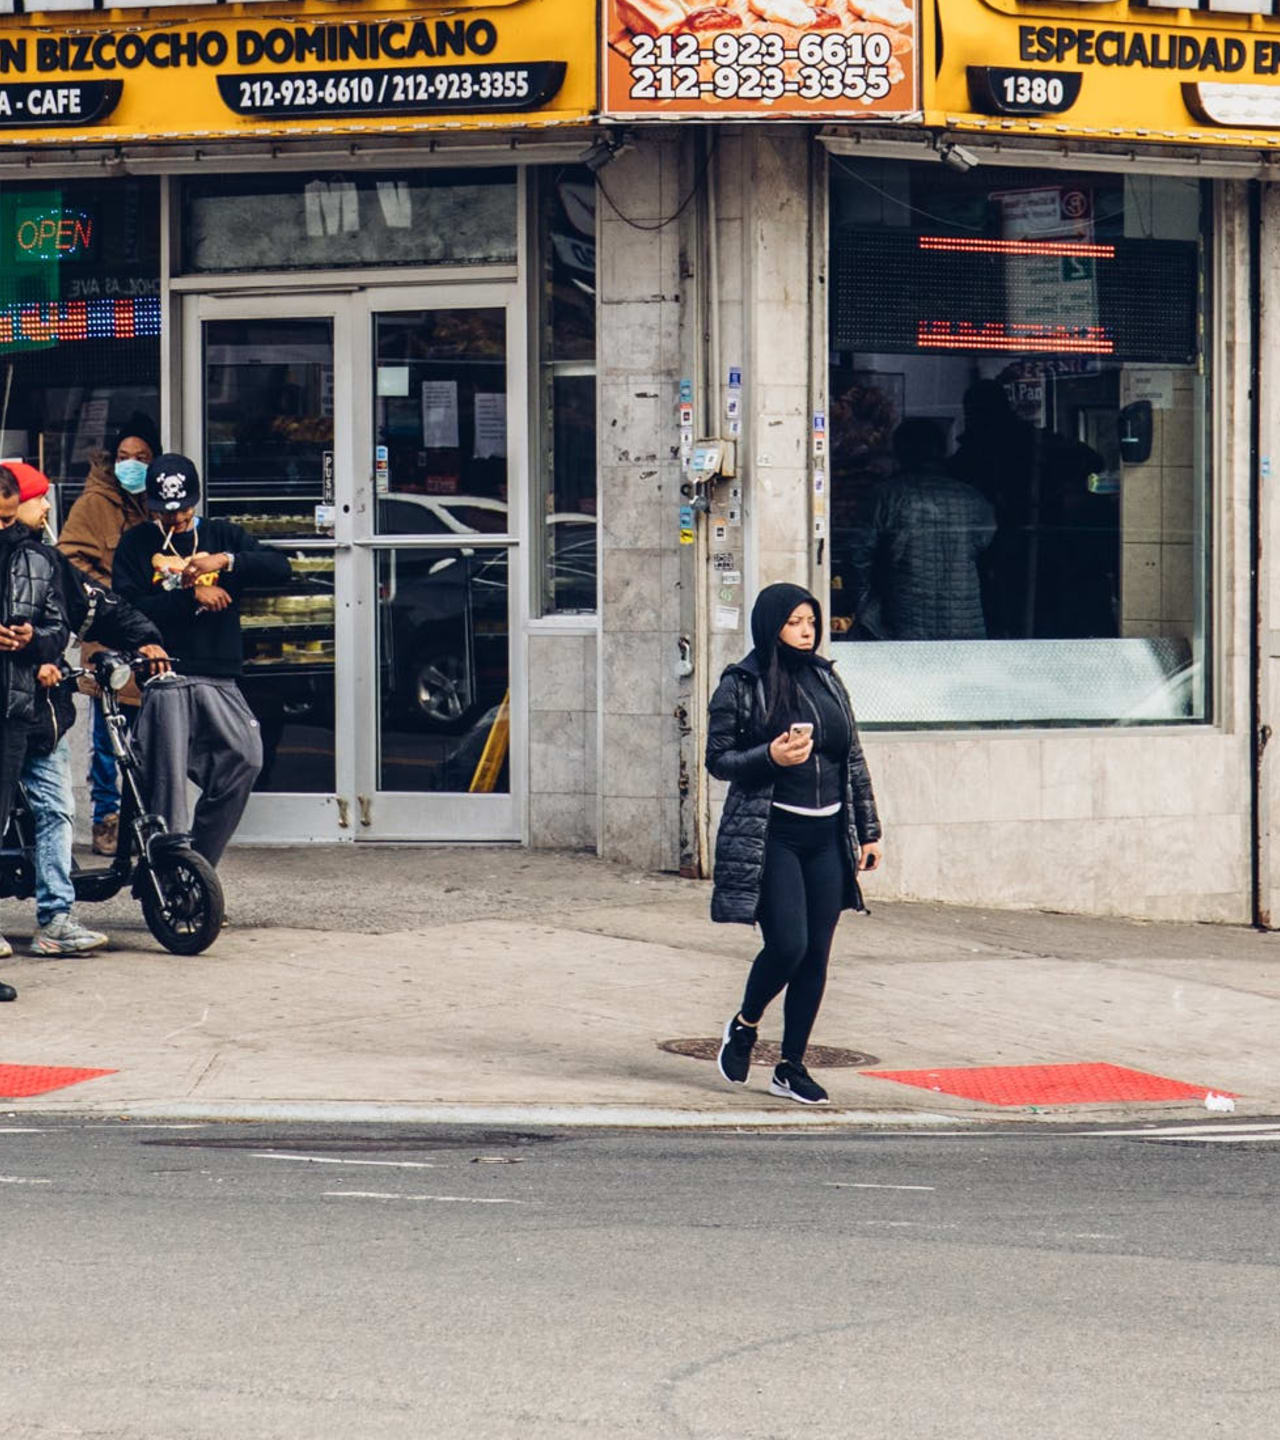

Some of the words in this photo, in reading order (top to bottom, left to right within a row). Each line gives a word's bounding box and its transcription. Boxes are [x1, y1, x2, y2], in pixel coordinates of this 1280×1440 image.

[36, 30, 228, 72] BIZCOCHO
[237, 19, 498, 66] DOMINICANO
[630, 32, 892, 67] 212-923-6610
[1018, 25, 1247, 73] ESPECIALIDAD
[239, 77, 374, 108] 212-923-6610
[392, 71, 530, 102] 212-923-3355
[629, 66, 891, 100] 212-923-3355
[1003, 75, 1064, 106] 1380
[27, 87, 82, 116] CAFE
[17, 219, 93, 250] OPEN
